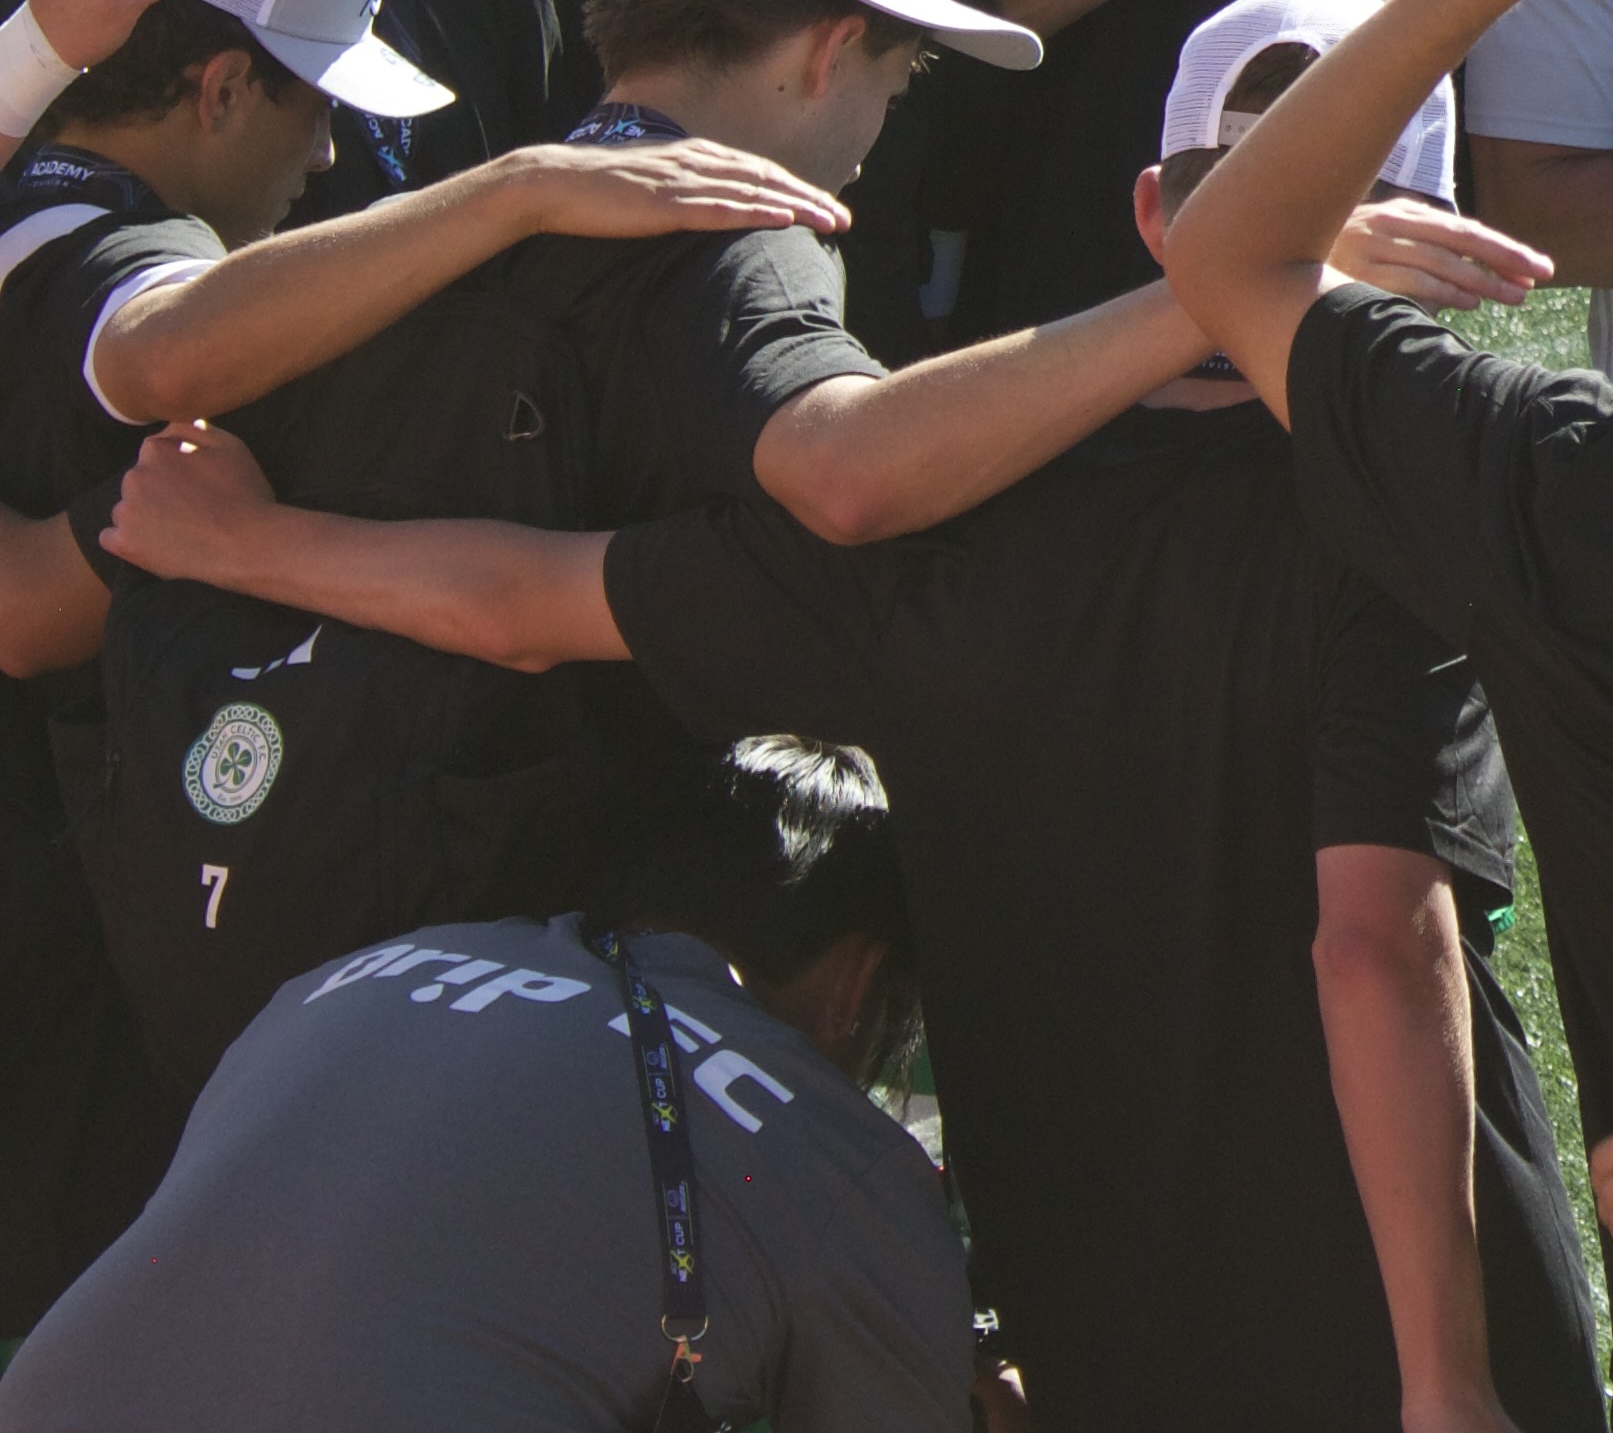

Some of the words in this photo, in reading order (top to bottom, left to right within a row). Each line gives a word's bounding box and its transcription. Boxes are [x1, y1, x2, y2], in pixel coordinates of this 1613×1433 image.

[230, 724, 261, 744] CELTIC
[201, 864, 229, 929] 7
[655, 1077, 667, 1099] CUP
[674, 1222, 685, 1246] CUP
